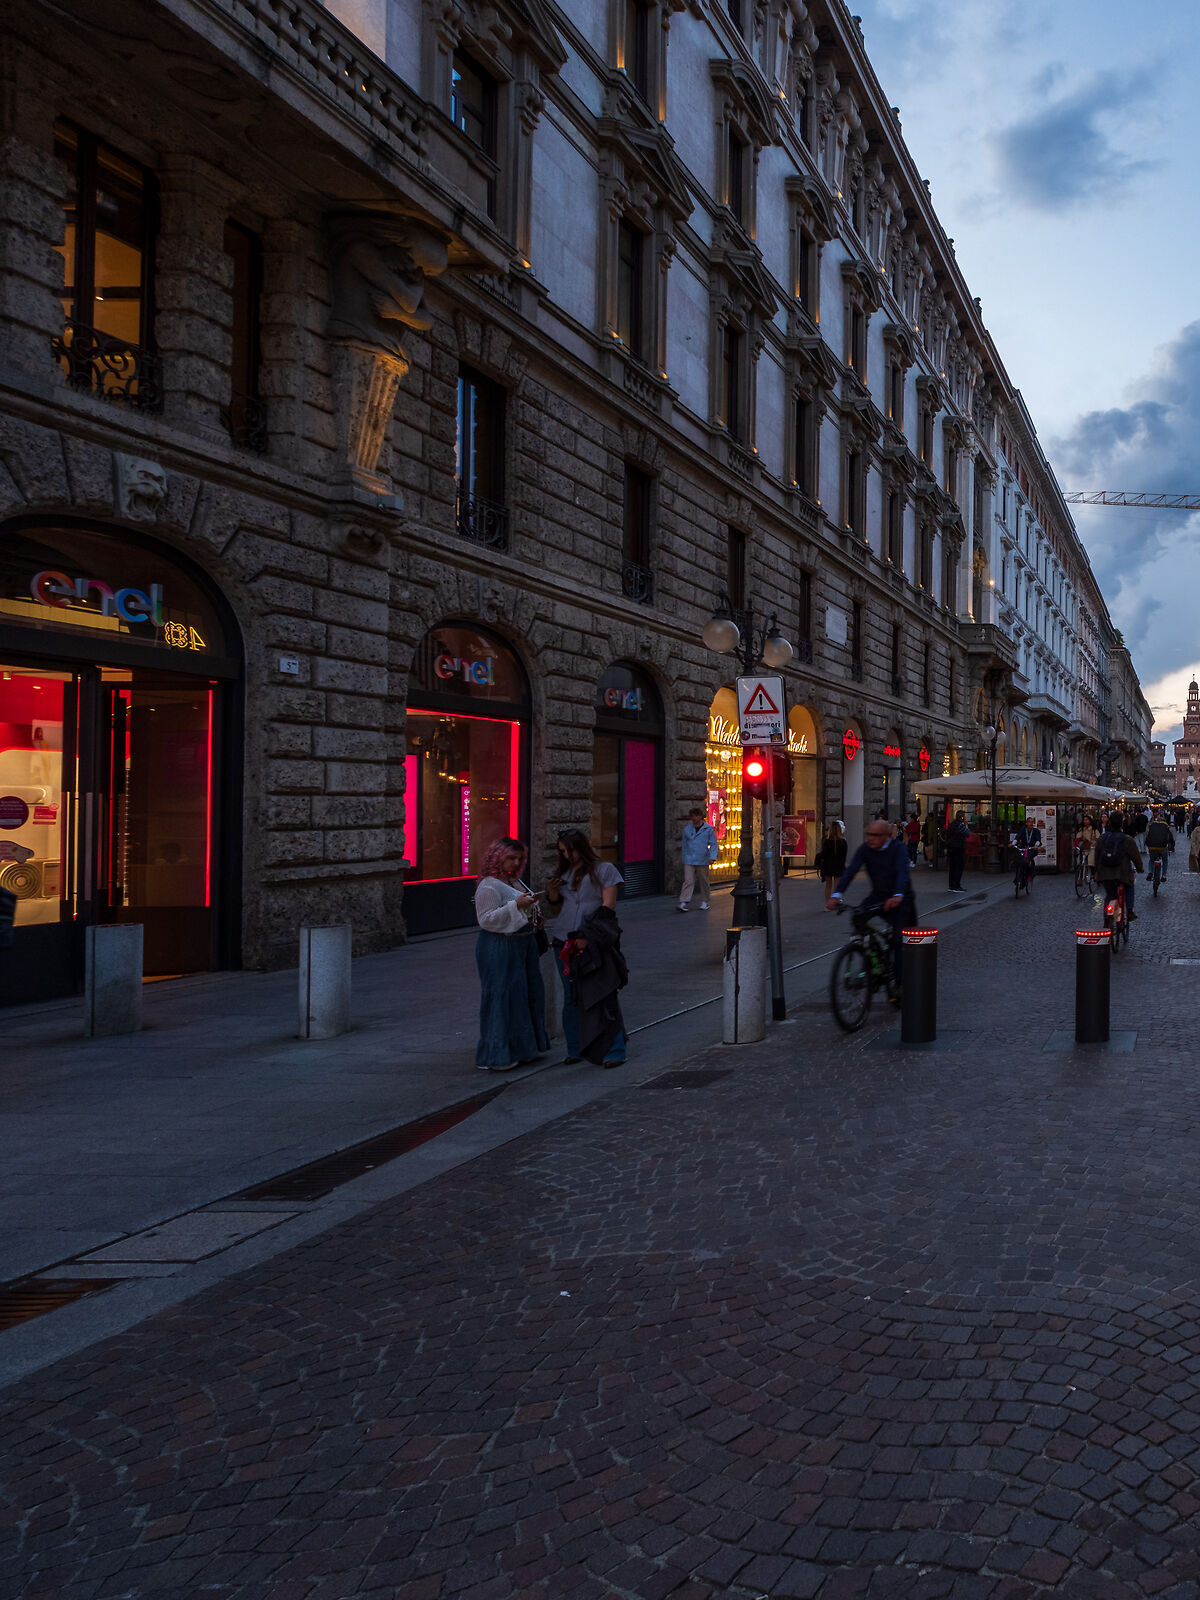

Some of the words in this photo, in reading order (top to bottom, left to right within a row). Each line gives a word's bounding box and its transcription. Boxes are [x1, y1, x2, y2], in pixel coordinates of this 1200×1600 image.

[30, 571, 164, 627] enel
[434, 654, 495, 686] enel
[604, 688, 644, 711] enel
